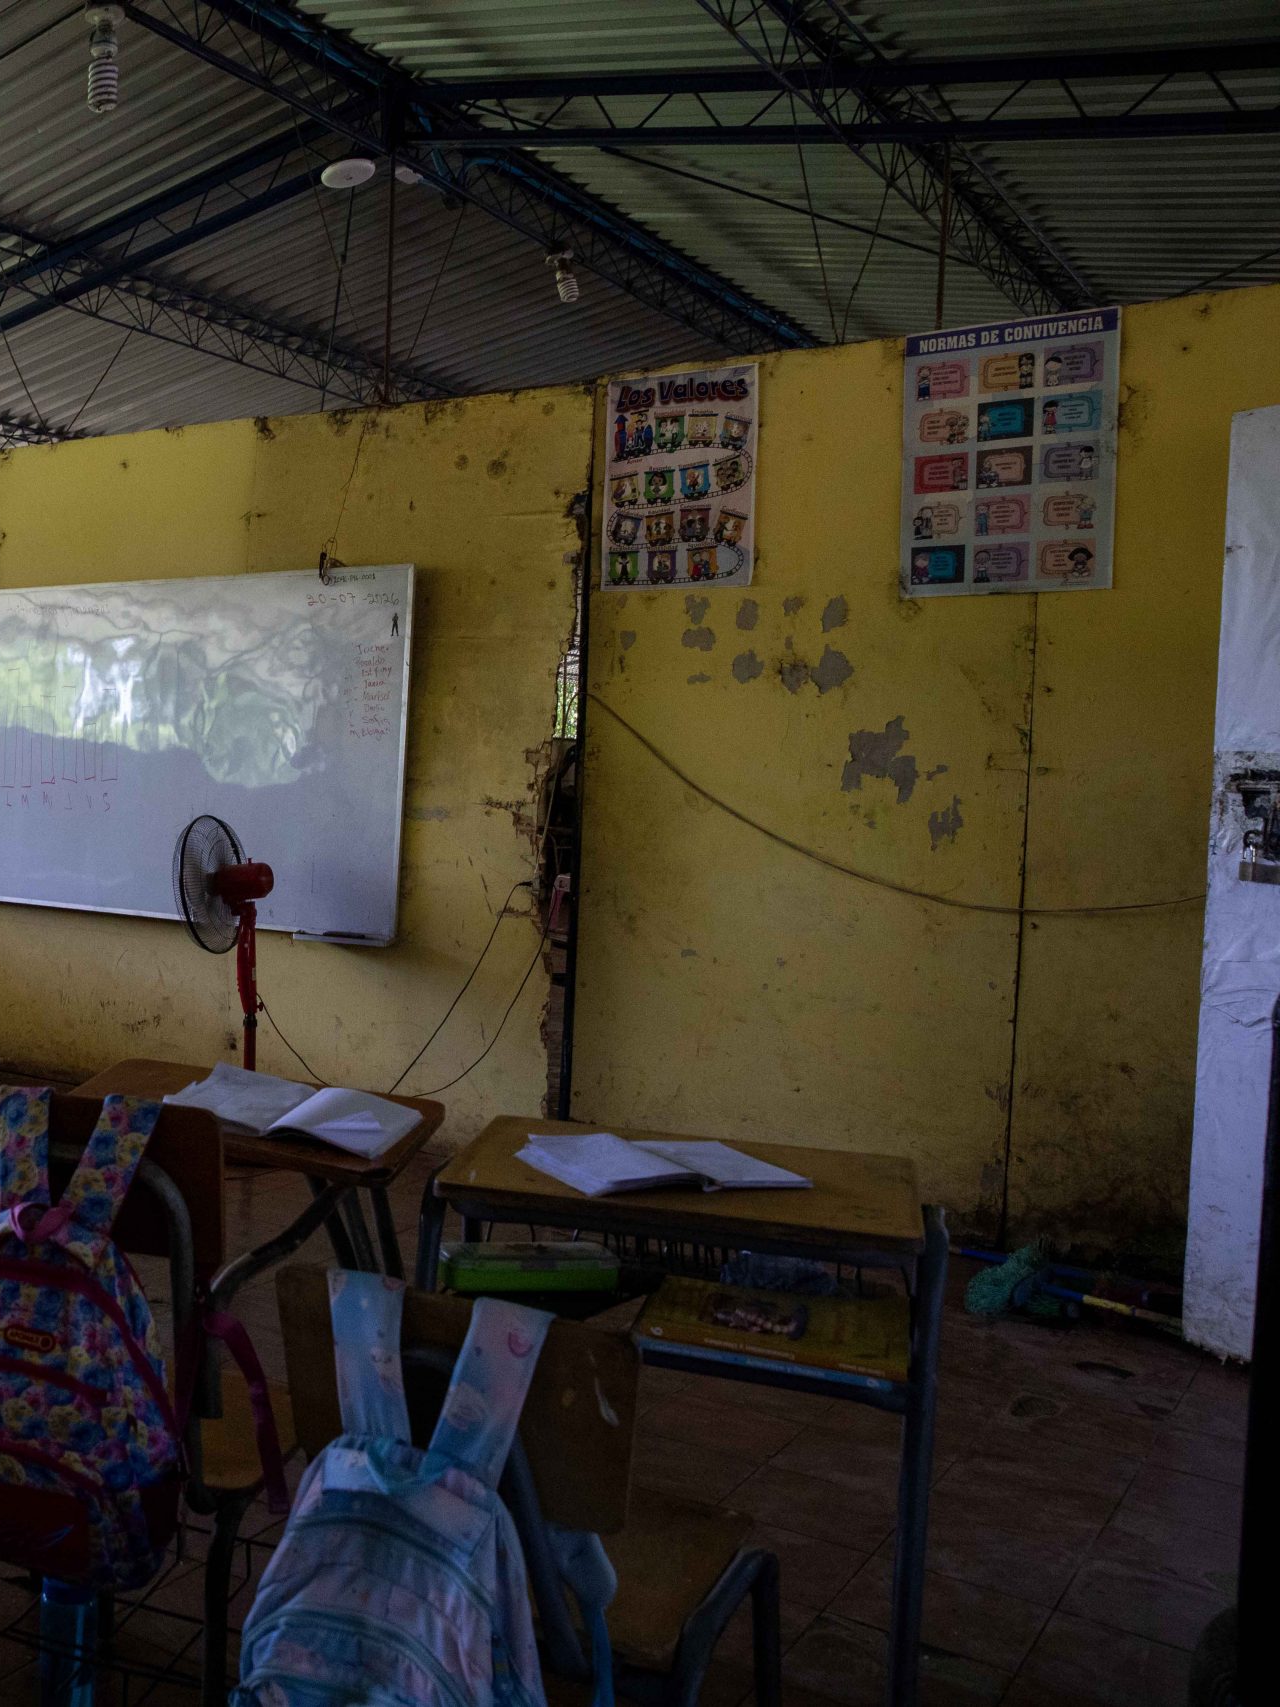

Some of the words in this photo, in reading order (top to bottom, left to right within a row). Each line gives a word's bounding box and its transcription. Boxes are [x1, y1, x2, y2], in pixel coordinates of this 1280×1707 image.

[919, 334, 976, 354] NORMAS
[980, 327, 999, 345] DE
[1004, 315, 1104, 343] CONVIVENCIA
[616, 384, 655, 411] Los
[658, 377, 749, 402] Valores
